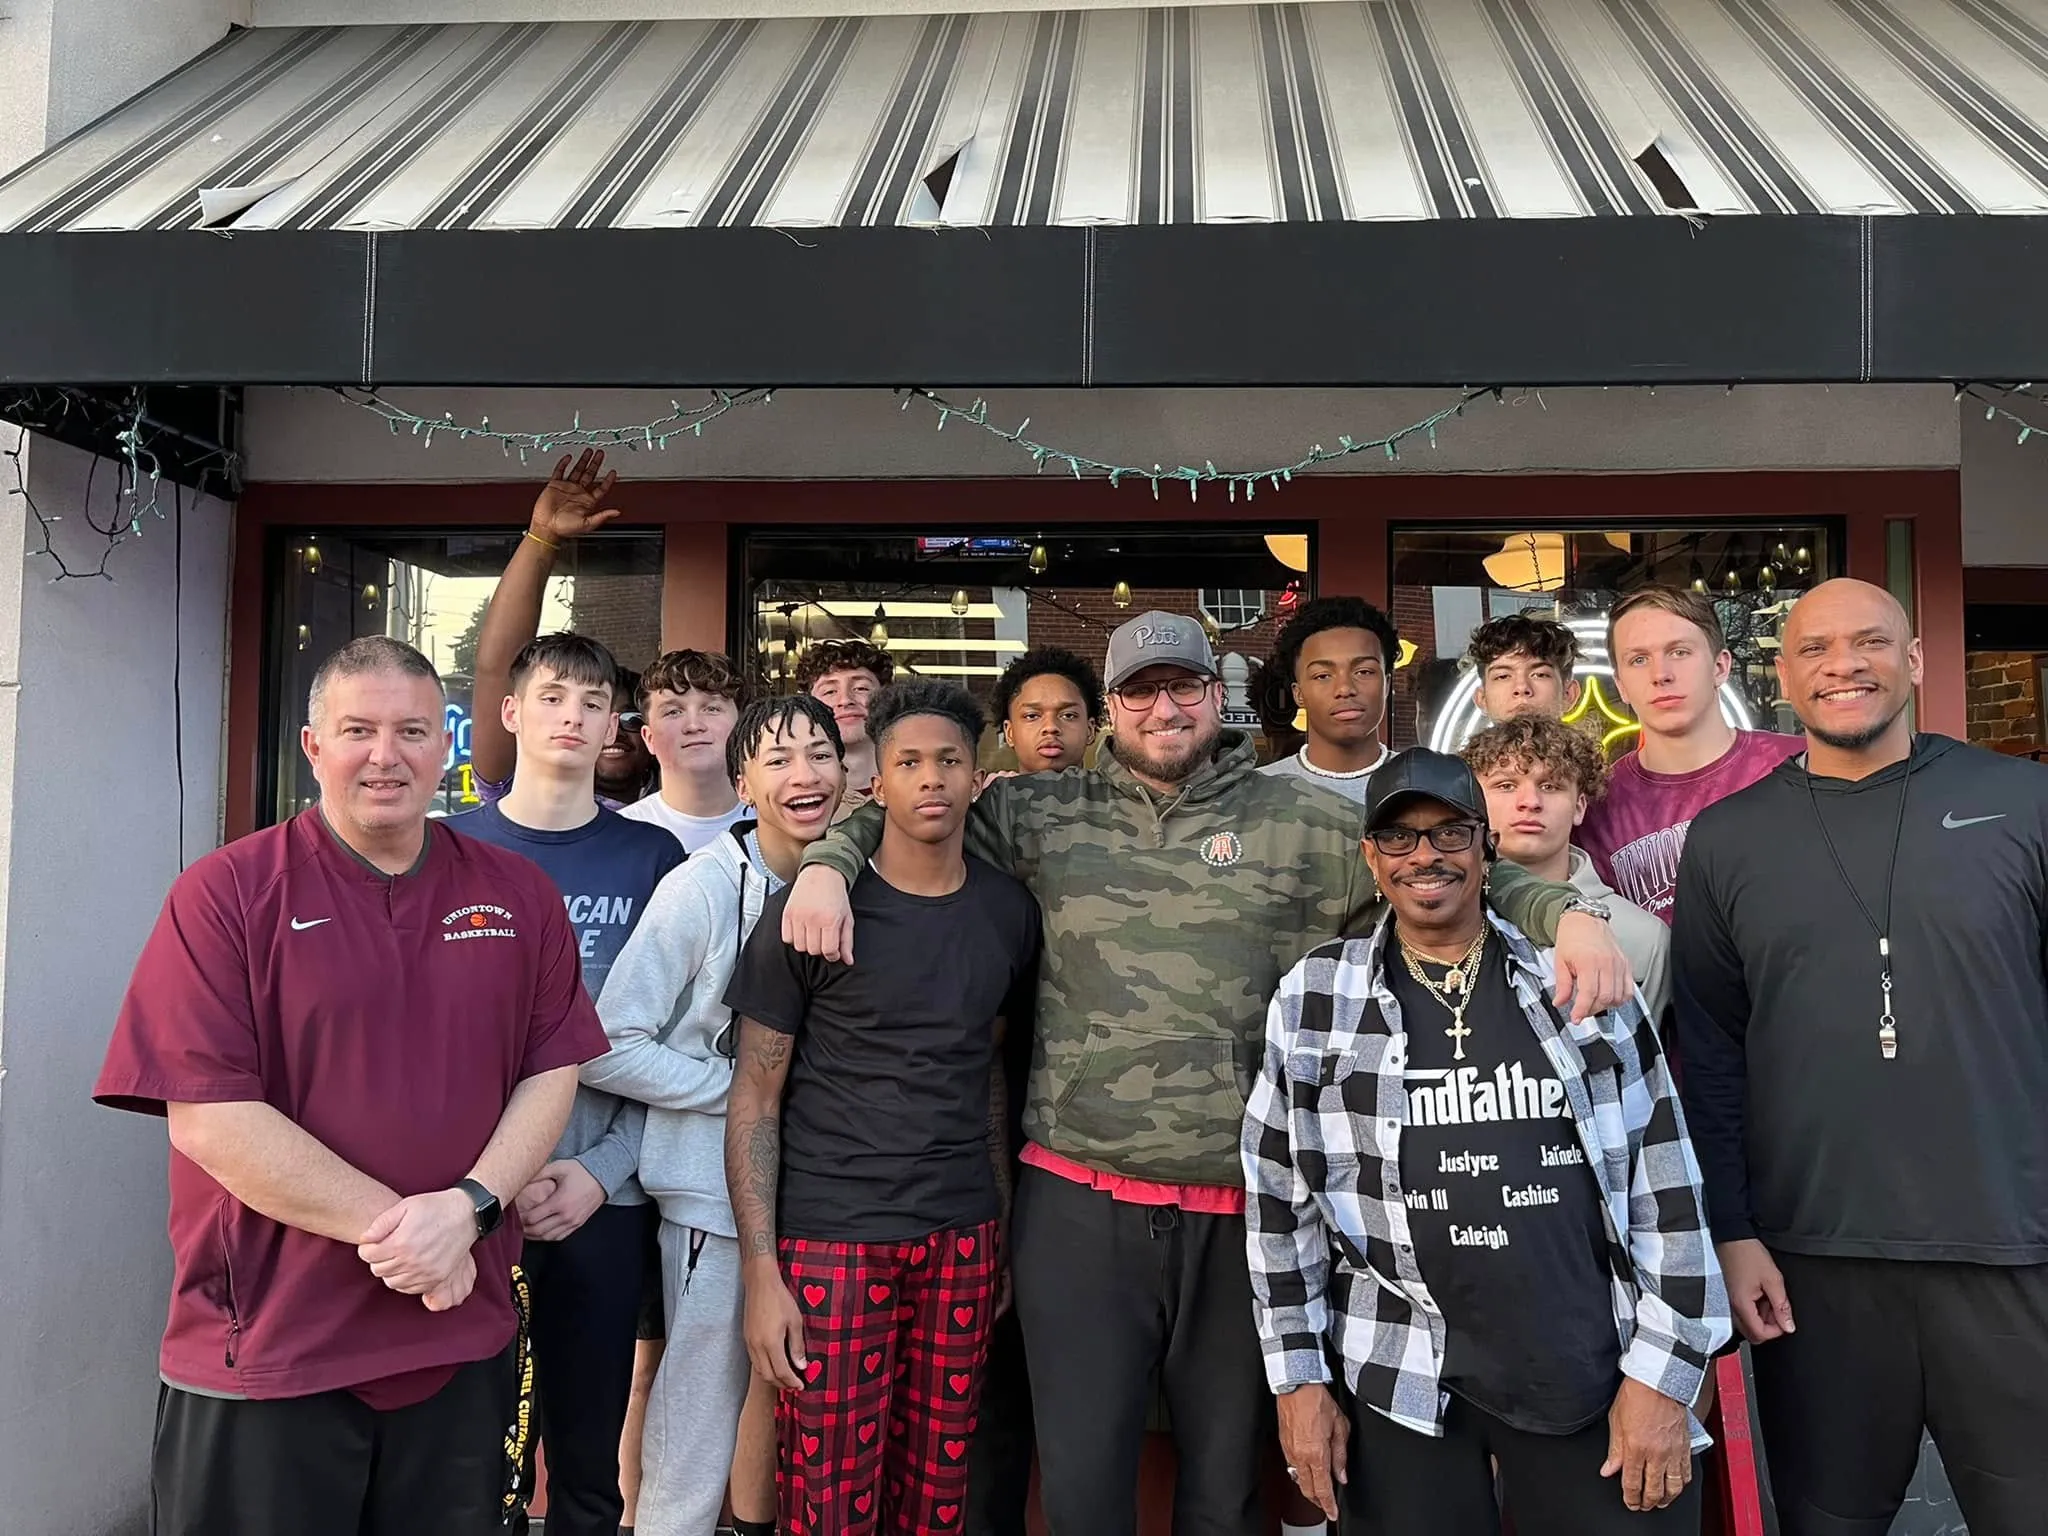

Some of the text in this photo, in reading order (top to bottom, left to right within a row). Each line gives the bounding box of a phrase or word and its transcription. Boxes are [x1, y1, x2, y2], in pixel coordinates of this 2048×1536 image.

[441, 904, 513, 925] UNIONTOWN
[443, 928, 517, 941] BASKETBALL
[1438, 1151, 1499, 1177] Justyce
[1502, 1184, 1560, 1207] Cashius
[1449, 1224, 1509, 1250] Caleigh
[520, 1356, 533, 1396] STEEL
